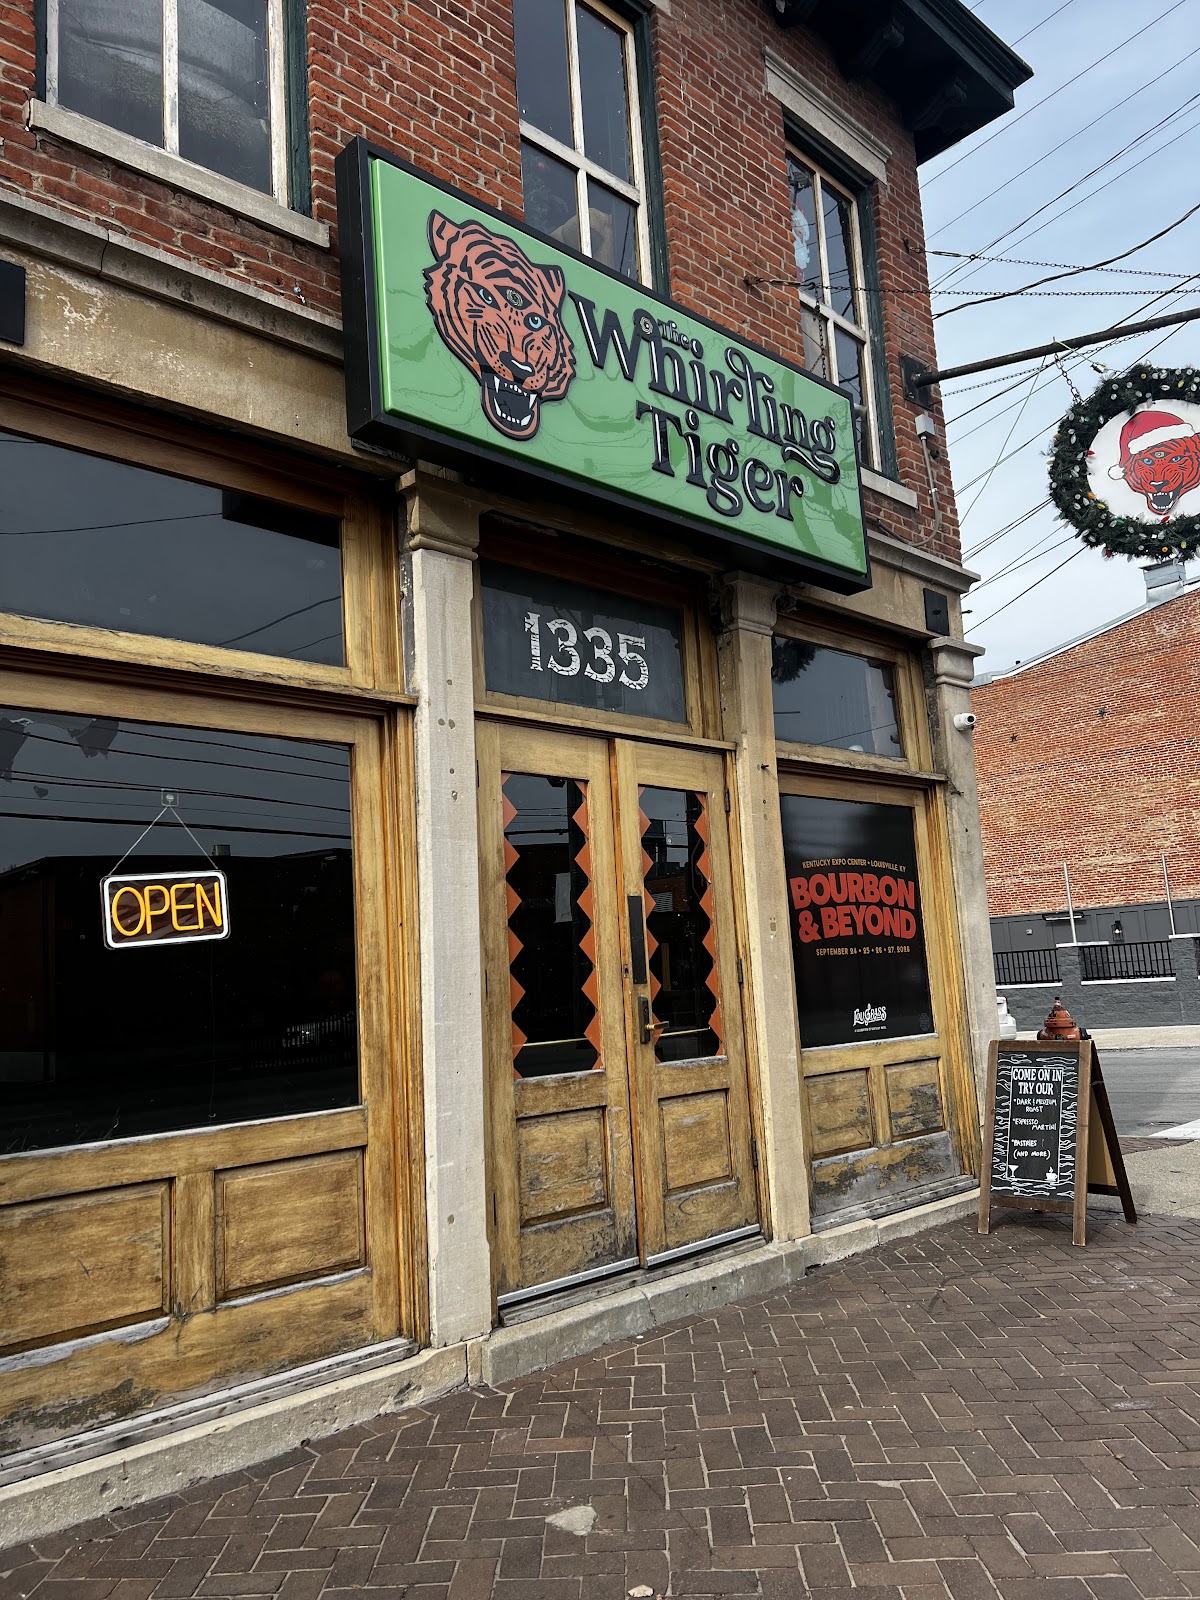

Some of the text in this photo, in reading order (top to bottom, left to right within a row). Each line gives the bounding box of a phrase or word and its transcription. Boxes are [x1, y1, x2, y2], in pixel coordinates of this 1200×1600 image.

[568, 290, 840, 484] Whirling
[635, 399, 804, 521] Tiger
[524, 611, 649, 690] 1335
[802, 859, 831, 869] KENTUCKY
[831, 858, 847, 866] EXPO
[847, 858, 867, 866] CENTER
[898, 865, 907, 873] KY
[789, 872, 915, 910] BOURBON
[111, 882, 222, 937] OPEN
[798, 905, 917, 943] & BEYOND
[815, 947, 849, 956] SEPTEMBER
[1012, 1068, 1062, 1082] COME ON IN
[1018, 1081, 1054, 1095] TRY OUR
[1025, 1105, 1044, 1113] ROAST
[1036, 1098, 1057, 1107] MEDIUM
[1031, 1123, 1057, 1131] MARTINI
